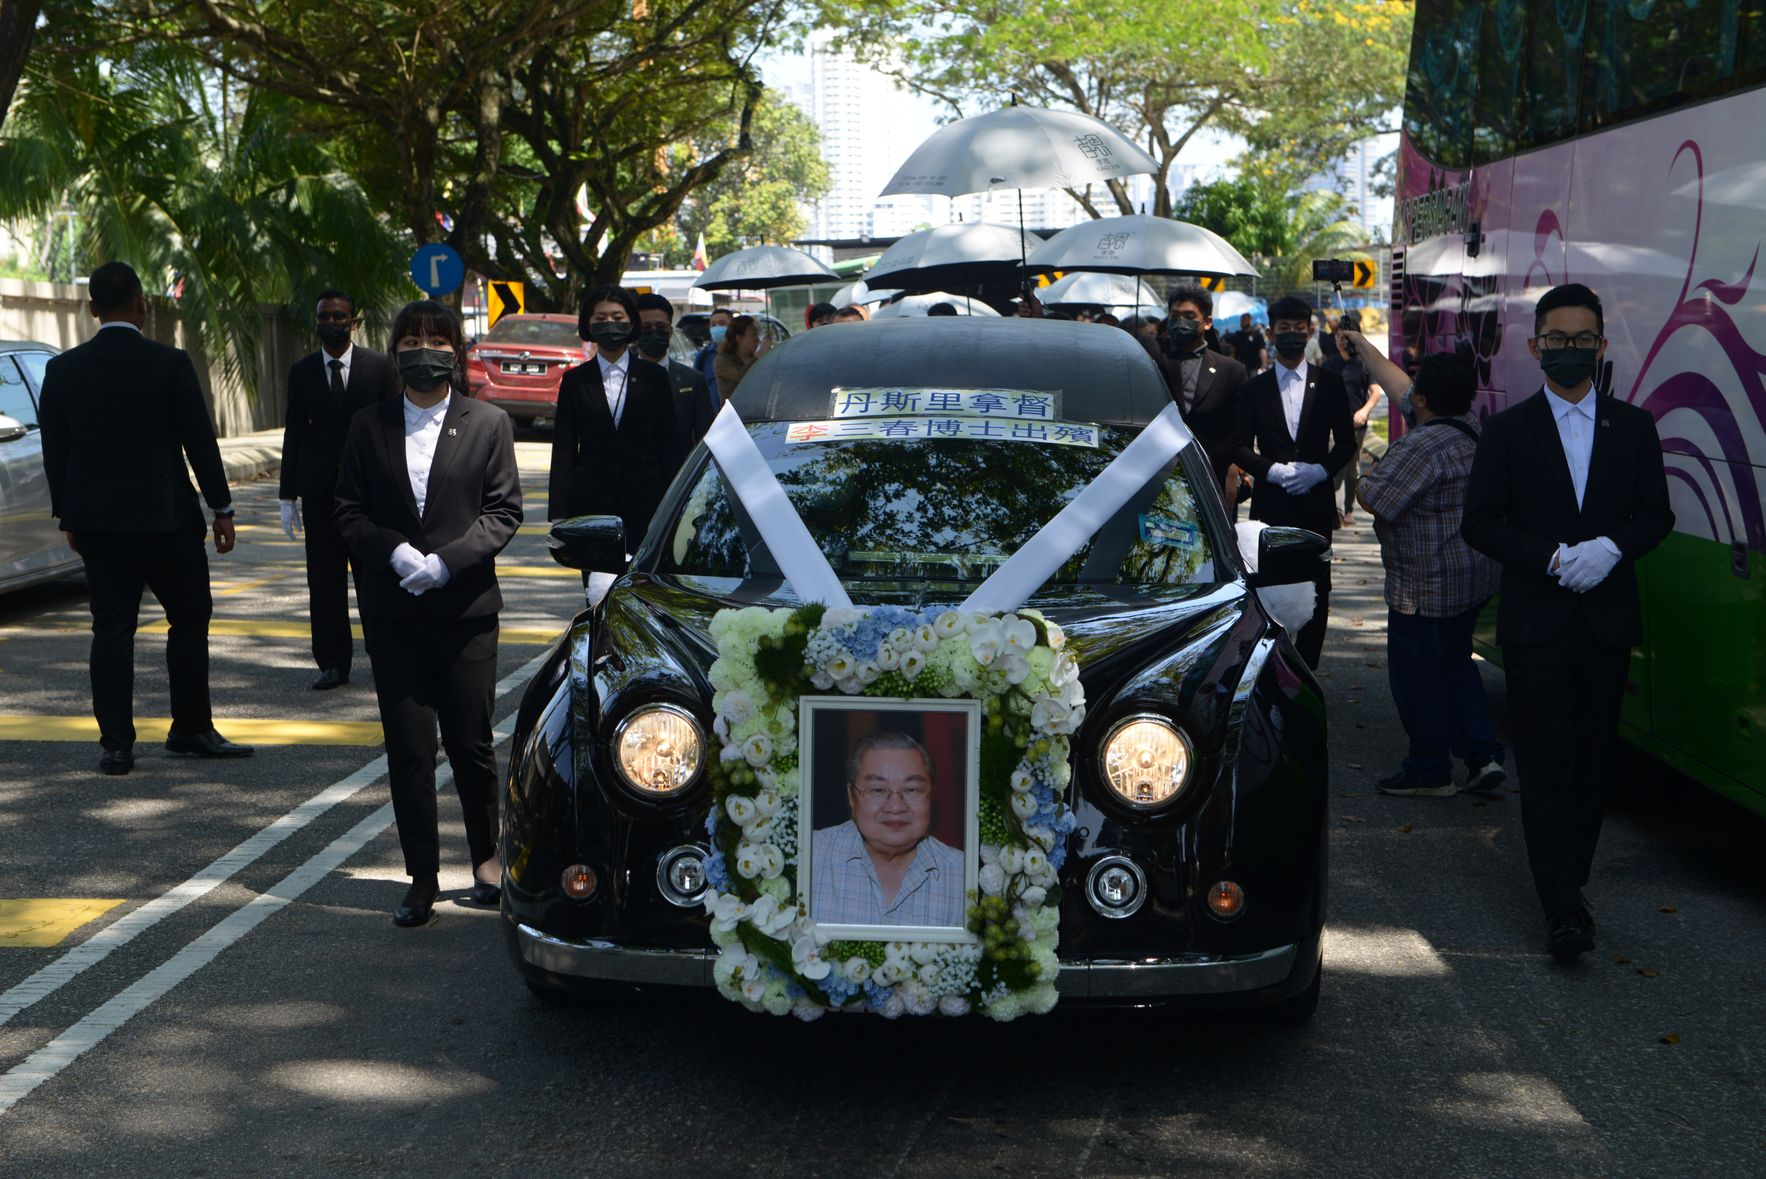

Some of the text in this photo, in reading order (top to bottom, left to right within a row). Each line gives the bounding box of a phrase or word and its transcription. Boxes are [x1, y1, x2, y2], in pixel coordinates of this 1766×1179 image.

[838, 391, 1052, 417] 丹斯里拿督
[789, 418, 1094, 444] 李三春博士出殯
